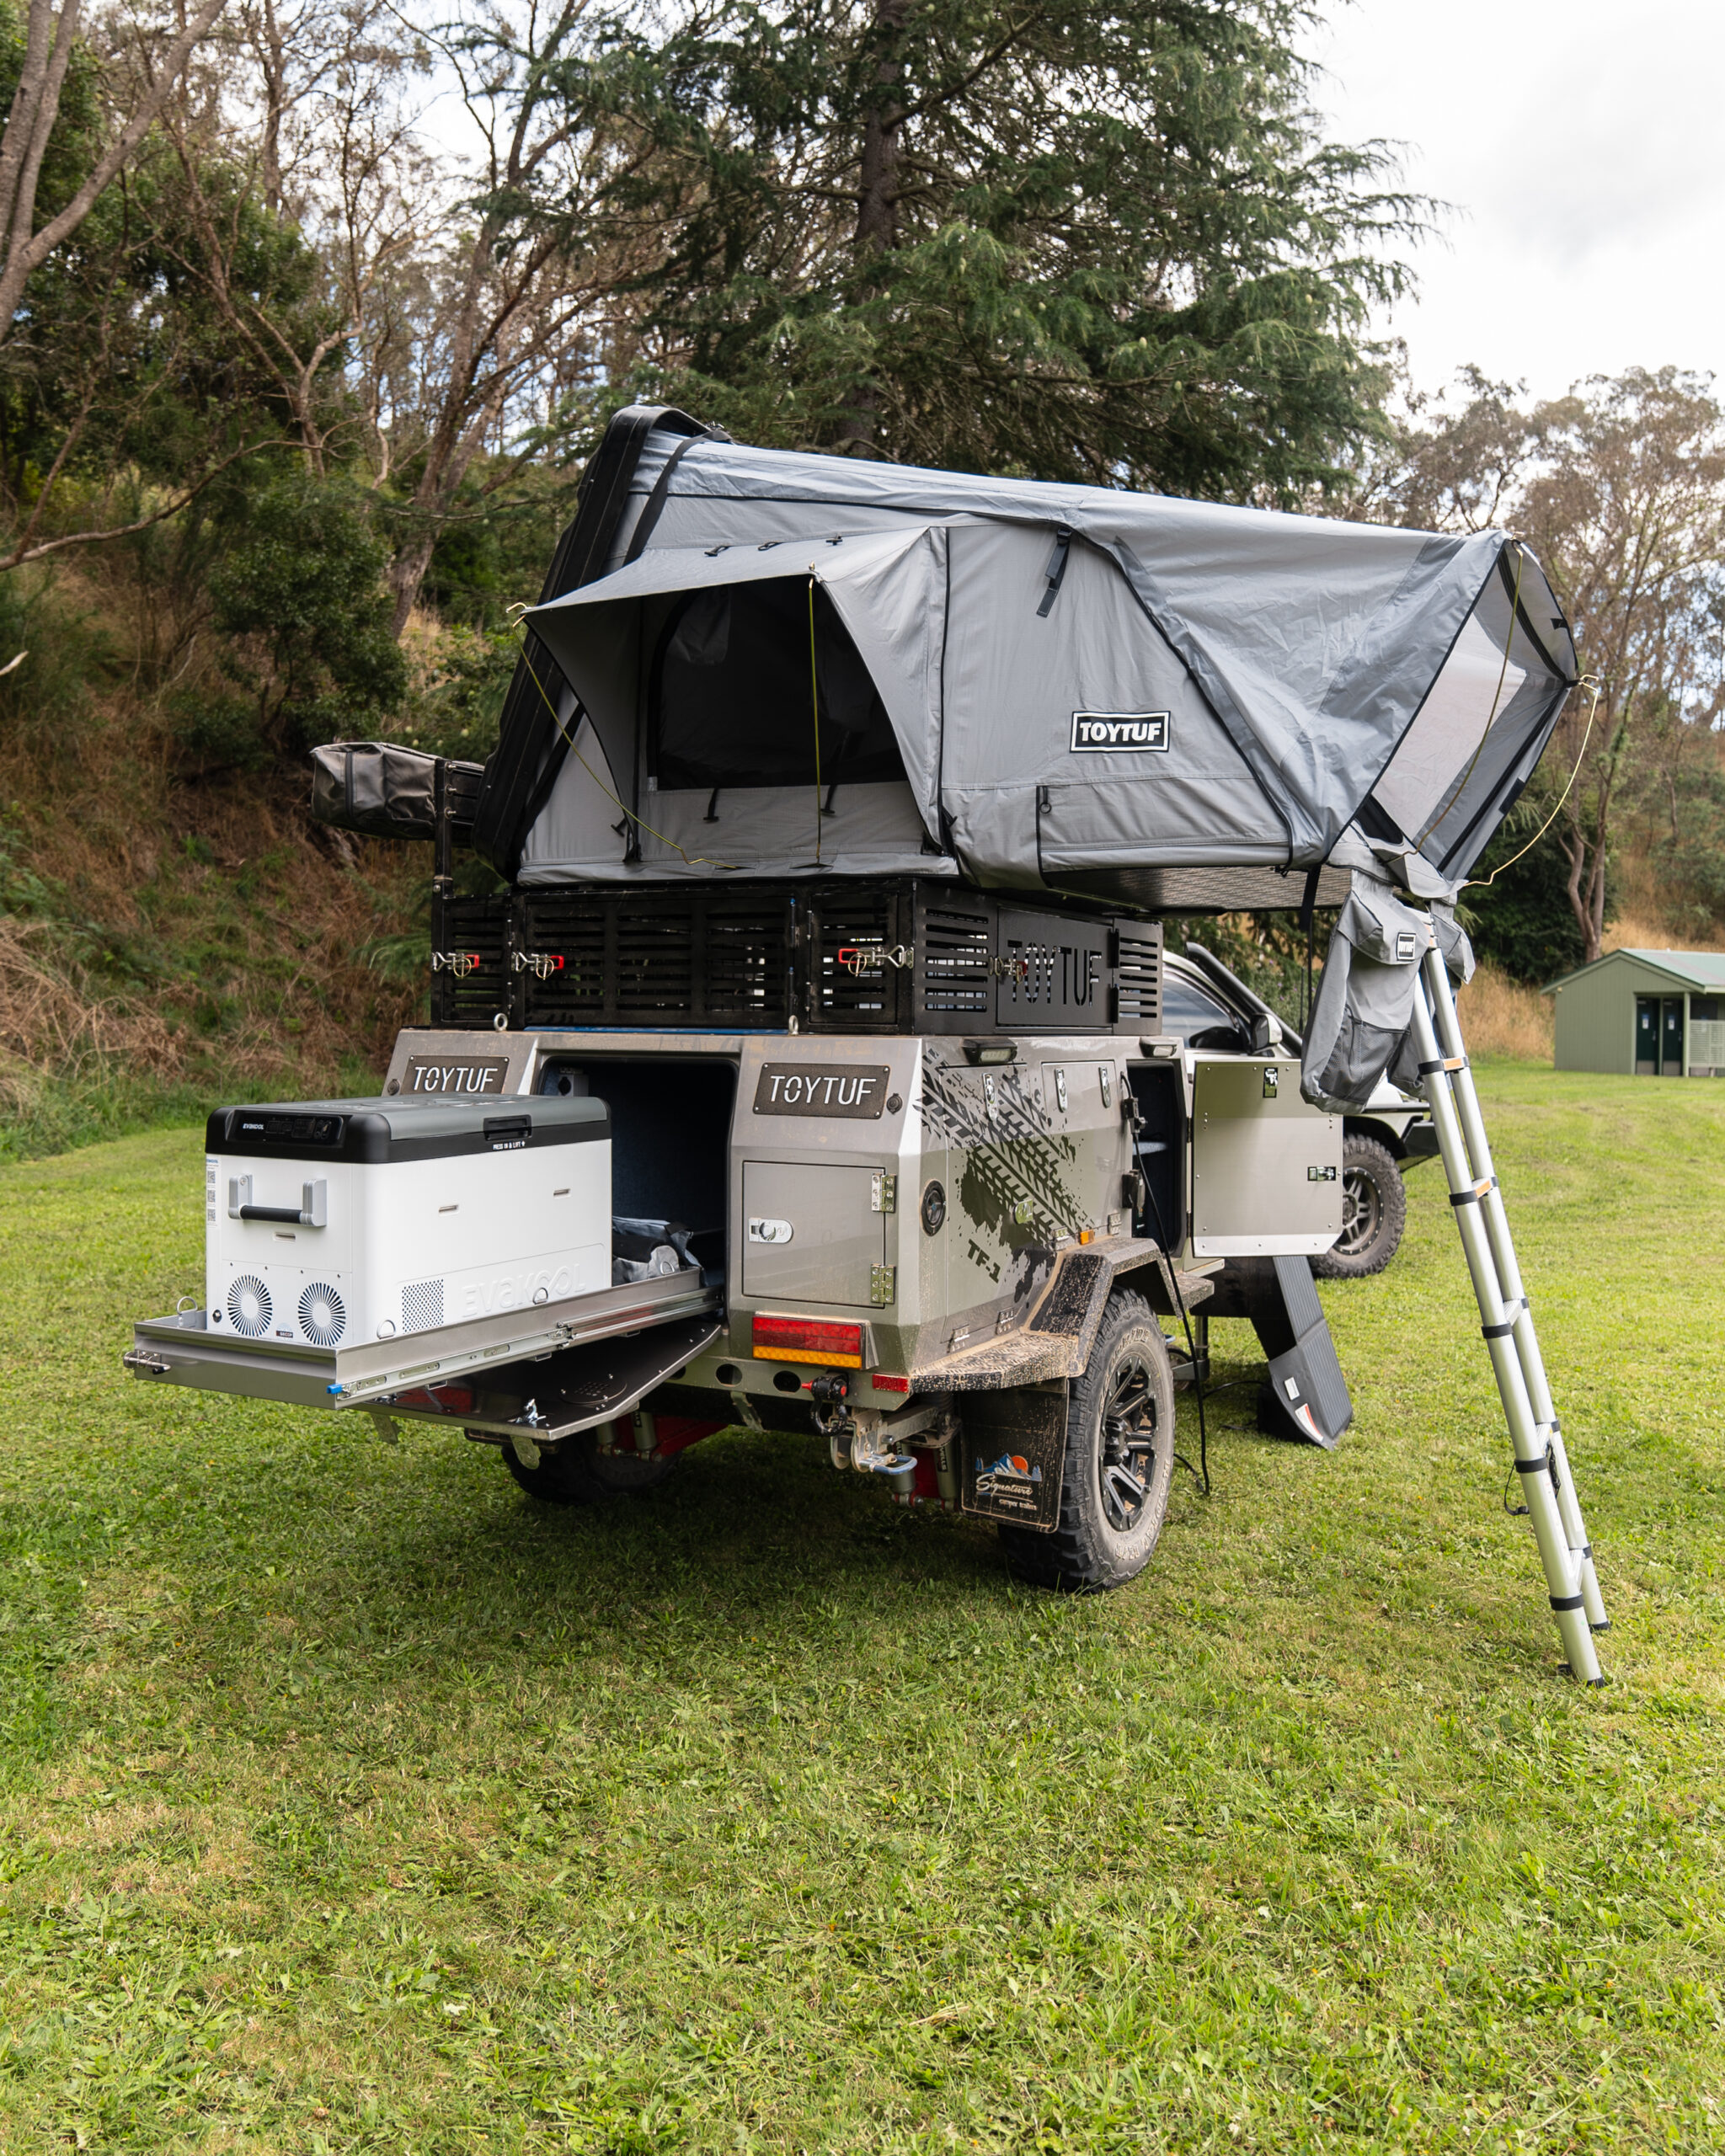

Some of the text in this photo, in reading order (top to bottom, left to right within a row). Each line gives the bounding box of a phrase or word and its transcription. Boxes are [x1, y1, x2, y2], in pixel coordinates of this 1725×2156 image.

[1079, 722, 1162, 742] TOYTUF
[1007, 939, 1102, 1007] TOYTUF
[414, 1066, 499, 1092] TOYTUF
[770, 1075, 877, 1106] TOYTUF
[968, 1238, 1001, 1284] TF-1
[976, 1473, 1033, 1497] Signature
